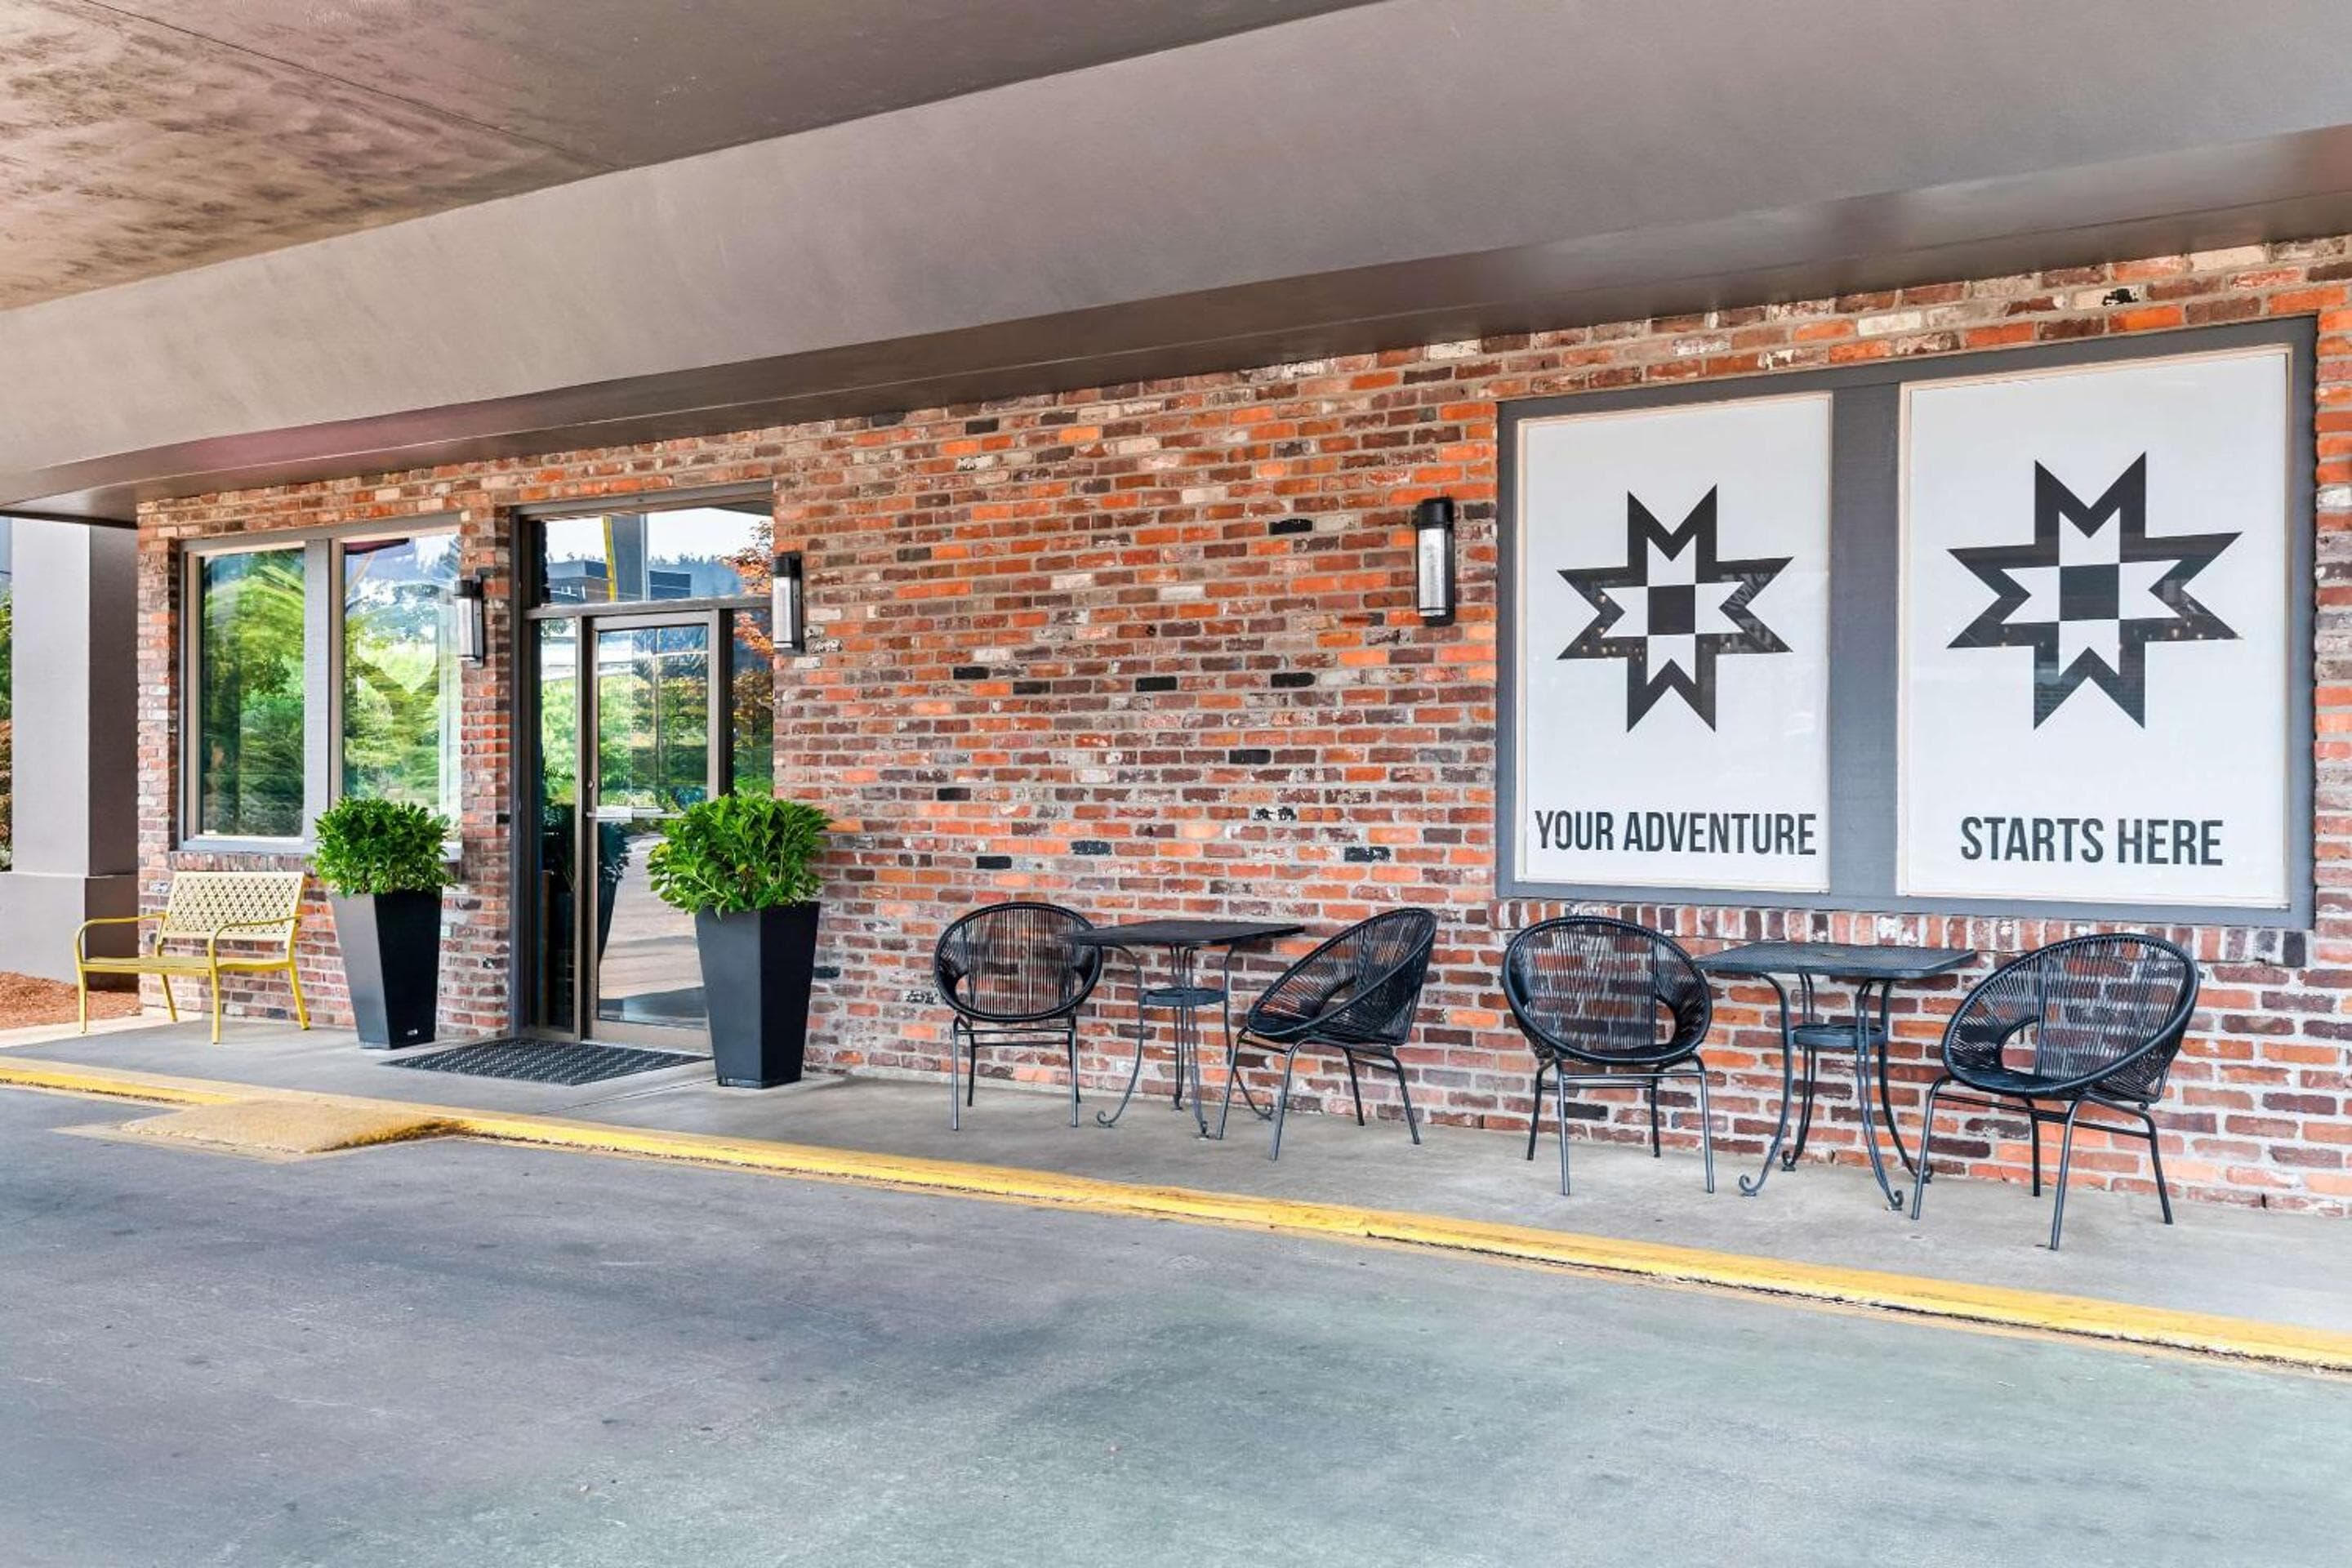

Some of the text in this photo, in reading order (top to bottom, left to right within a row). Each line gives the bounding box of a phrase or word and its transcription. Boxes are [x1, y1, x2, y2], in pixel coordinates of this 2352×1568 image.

[1535, 810, 1816, 855] YOUR ADVENTURE
[1961, 816, 2223, 866] STARTS HERE
